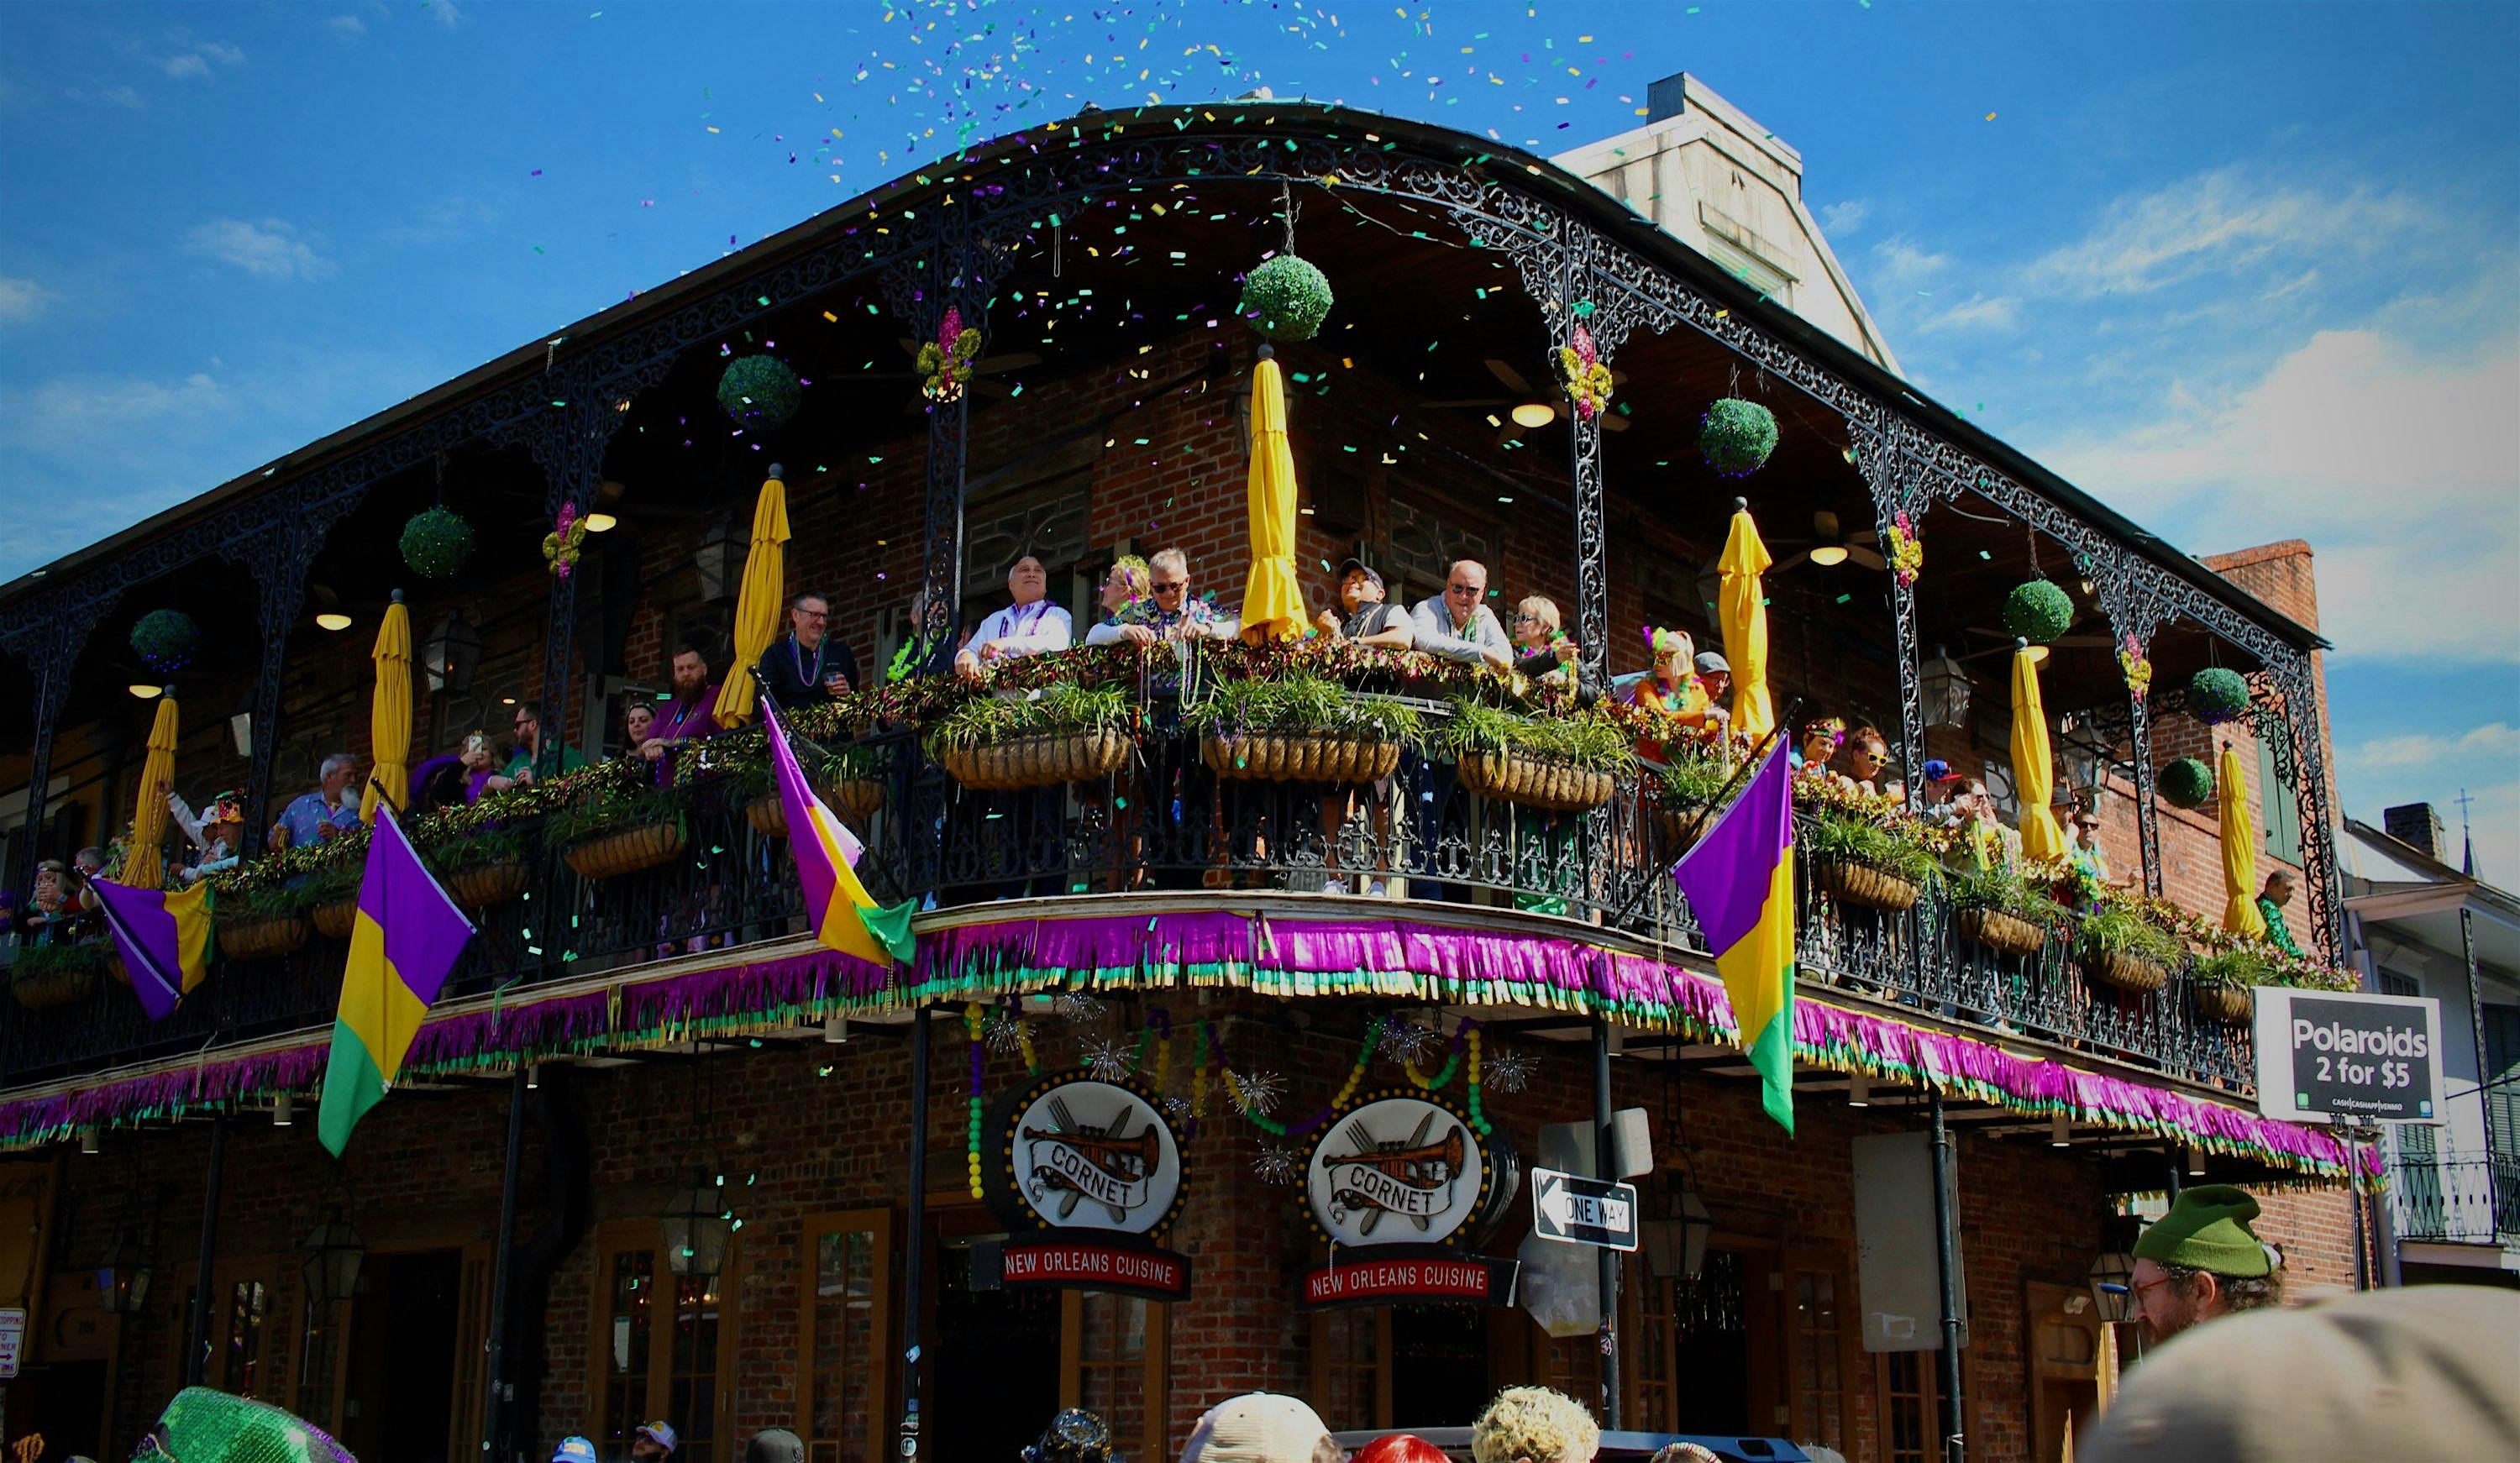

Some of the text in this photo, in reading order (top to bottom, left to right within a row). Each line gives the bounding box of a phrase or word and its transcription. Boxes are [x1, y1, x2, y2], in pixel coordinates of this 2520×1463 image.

[2293, 1019, 2428, 1058] Polaroids
[2316, 1057, 2411, 1089] 2 for $5
[1051, 1144, 1132, 1204] CORNET
[1351, 1166, 1435, 1213] CORNET
[1565, 1197, 1625, 1227] ONE WAY
[1005, 1251, 1173, 1285] NEW ORLEANS CUISINE
[1312, 1266, 1486, 1297] NEW ORLEANS CUISINE
[0, 1316, 24, 1324] TOPPING
